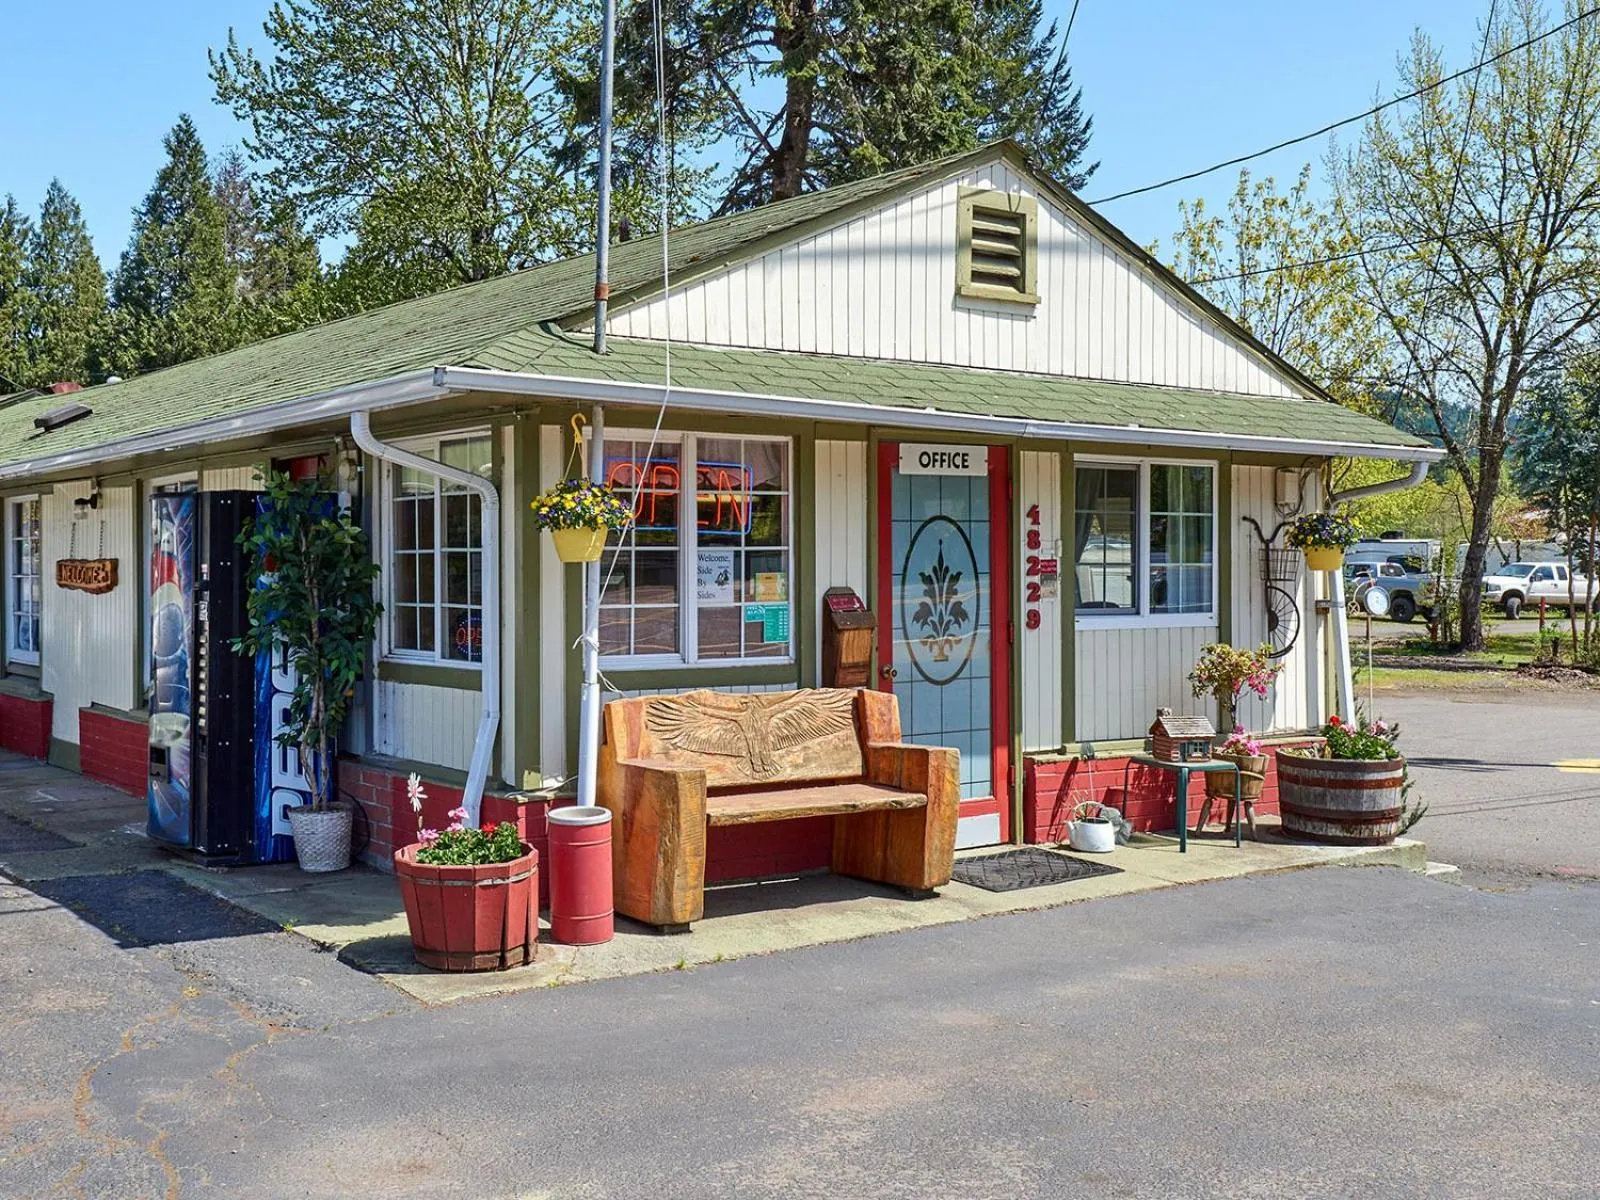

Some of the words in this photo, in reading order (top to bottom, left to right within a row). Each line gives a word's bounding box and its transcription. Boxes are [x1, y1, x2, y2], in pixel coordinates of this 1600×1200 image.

[919, 451, 970, 469] OFFICE
[697, 565, 713, 575] Side
[1026, 504, 1042, 630] 48229
[697, 577, 706, 587] By
[456, 627, 483, 645] OPE
[271, 624, 315, 837] PEPS
